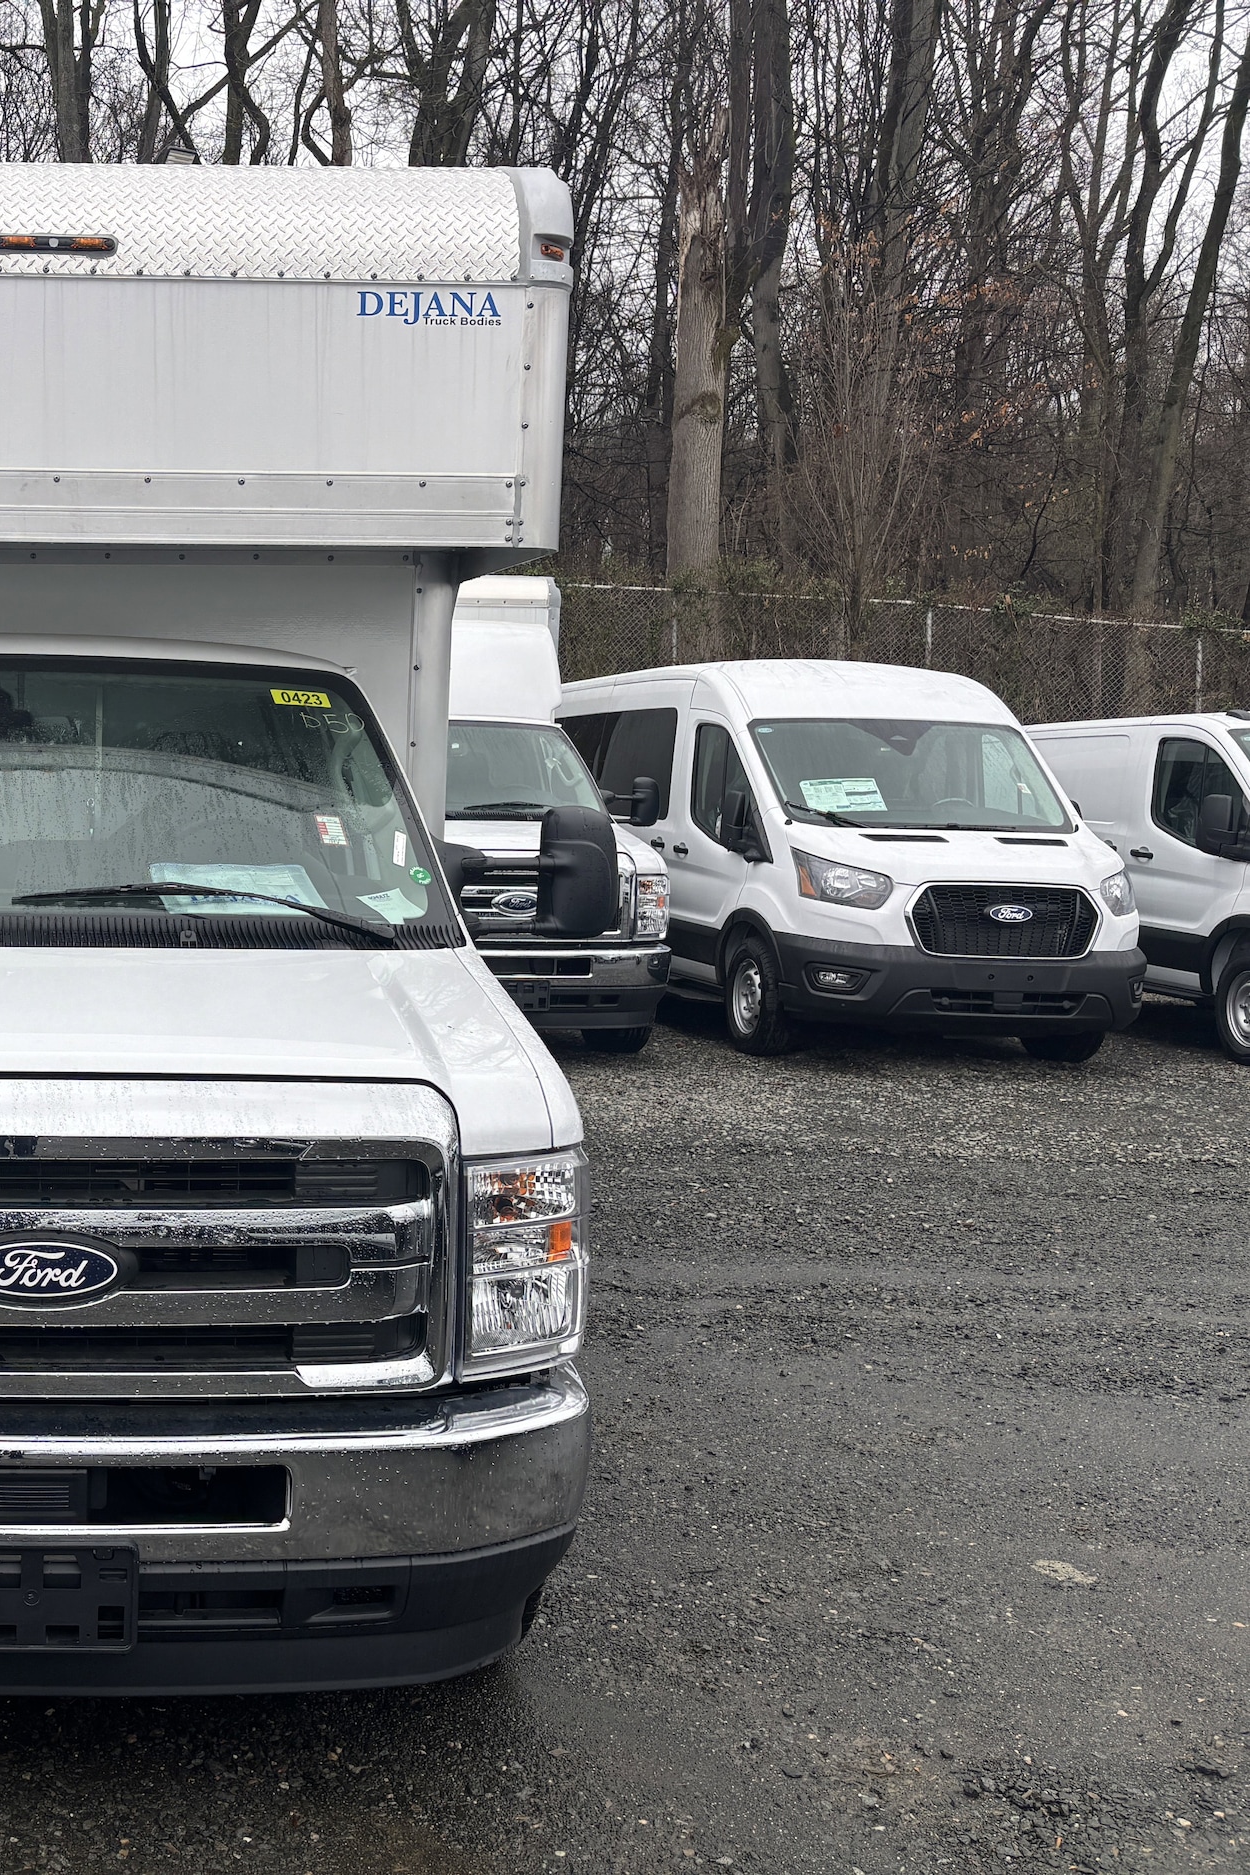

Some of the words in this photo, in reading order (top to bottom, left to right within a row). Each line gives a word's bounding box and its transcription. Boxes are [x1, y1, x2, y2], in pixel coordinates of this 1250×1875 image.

[356, 291, 502, 325] DEJANA
[423, 316, 456, 326] Truck
[460, 316, 502, 326] Bodies
[280, 691, 323, 706] 0423
[509, 897, 532, 908] Ford
[998, 907, 1025, 920] Ford
